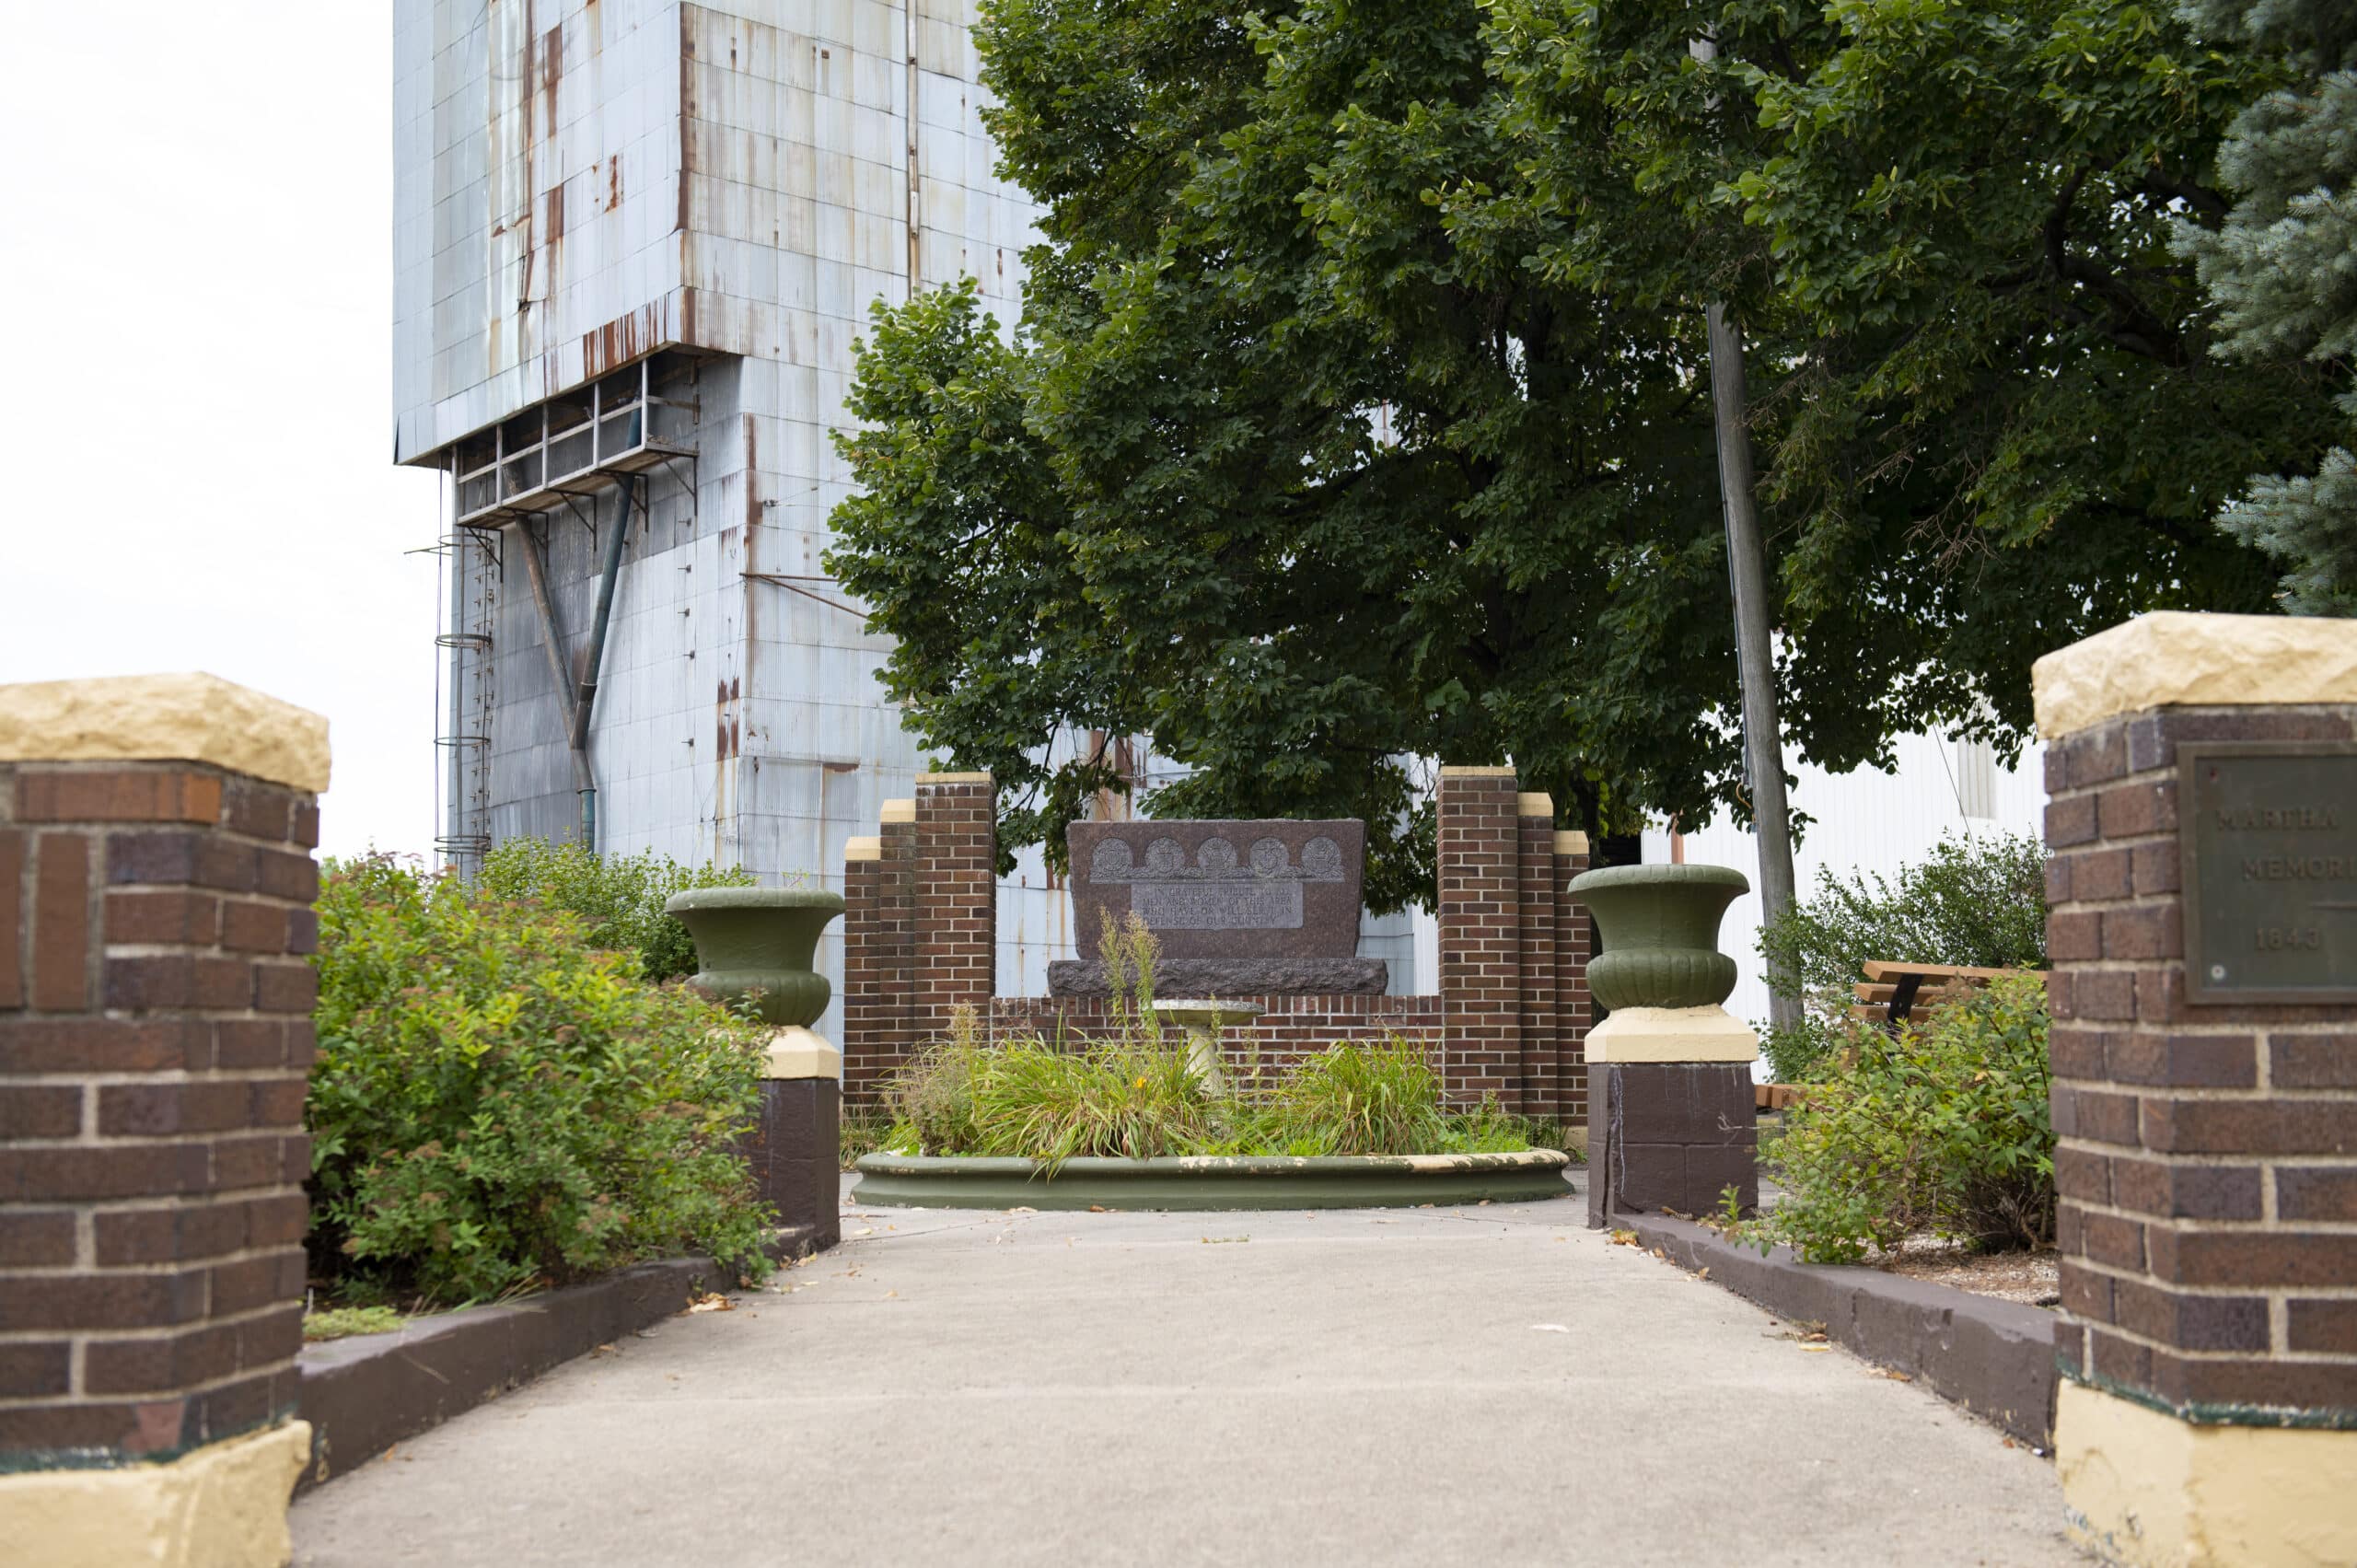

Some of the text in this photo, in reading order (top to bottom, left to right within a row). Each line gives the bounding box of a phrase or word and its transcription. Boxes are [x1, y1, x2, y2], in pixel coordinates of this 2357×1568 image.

[2215, 808, 2340, 830] MARTHA
[1168, 888, 1213, 897] GRATEFUL
[1143, 897, 1162, 906] MEN
[1167, 897, 1186, 906] AND
[1190, 897, 1224, 906] WOMEN
[1245, 897, 1265, 906] THIS
[1270, 896, 1292, 906] AREA
[1143, 907, 1165, 916] WHO
[1170, 907, 1195, 916] HAVE
[1219, 906, 1244, 915] WILL
[1282, 905, 1292, 914] IN
[2255, 926, 2322, 951] 1843
